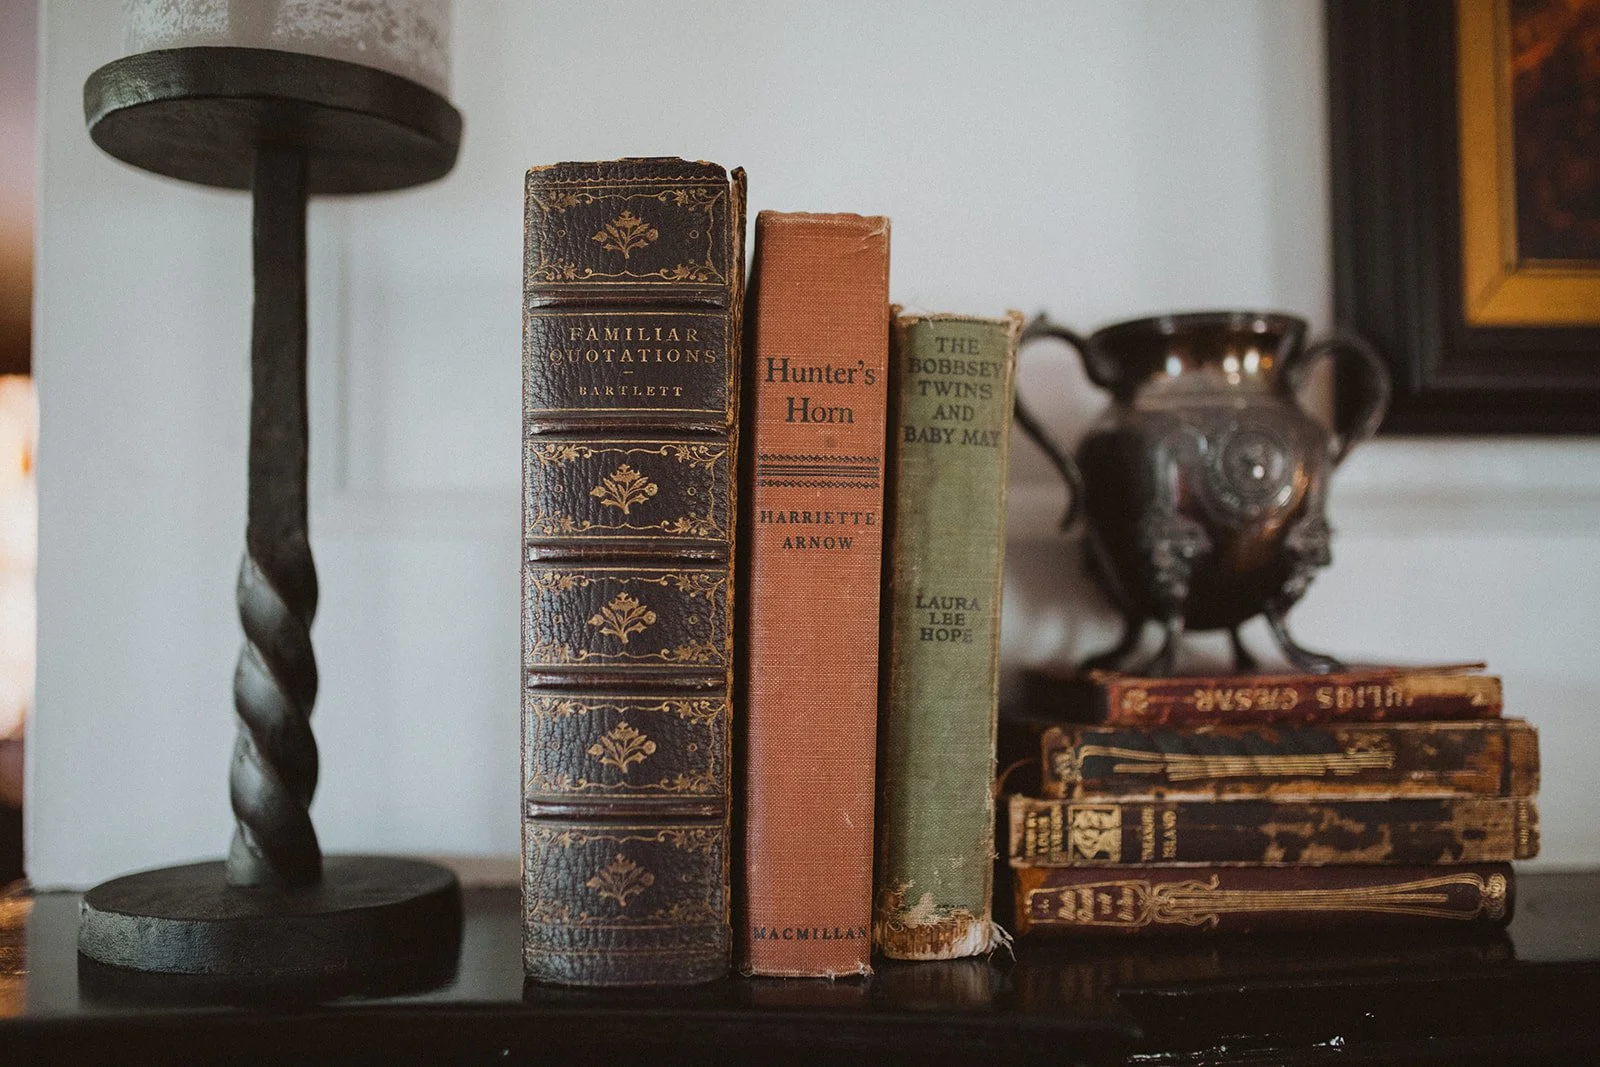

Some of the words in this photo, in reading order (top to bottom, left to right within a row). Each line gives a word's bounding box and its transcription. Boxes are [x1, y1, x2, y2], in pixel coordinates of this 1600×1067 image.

[569, 327, 700, 342] FAMILIAR
[935, 336, 980, 355] THE
[549, 349, 717, 366] QUOTATIONS
[766, 357, 876, 385] Hunter's
[907, 357, 1001, 379] BOBBSEY
[579, 385, 684, 397] BARTLETT
[918, 380, 993, 400] TWINS
[785, 397, 854, 423] Horn
[931, 405, 975, 422] AND
[903, 426, 955, 446] BABY
[961, 428, 1001, 448] MAY
[760, 510, 878, 525] HARRIETTE
[782, 536, 853, 550] ARNOW
[915, 594, 982, 612] LAURA
[929, 612, 966, 626] LEE
[919, 626, 973, 644] HOPE
[753, 927, 867, 940] MACMILLAN
